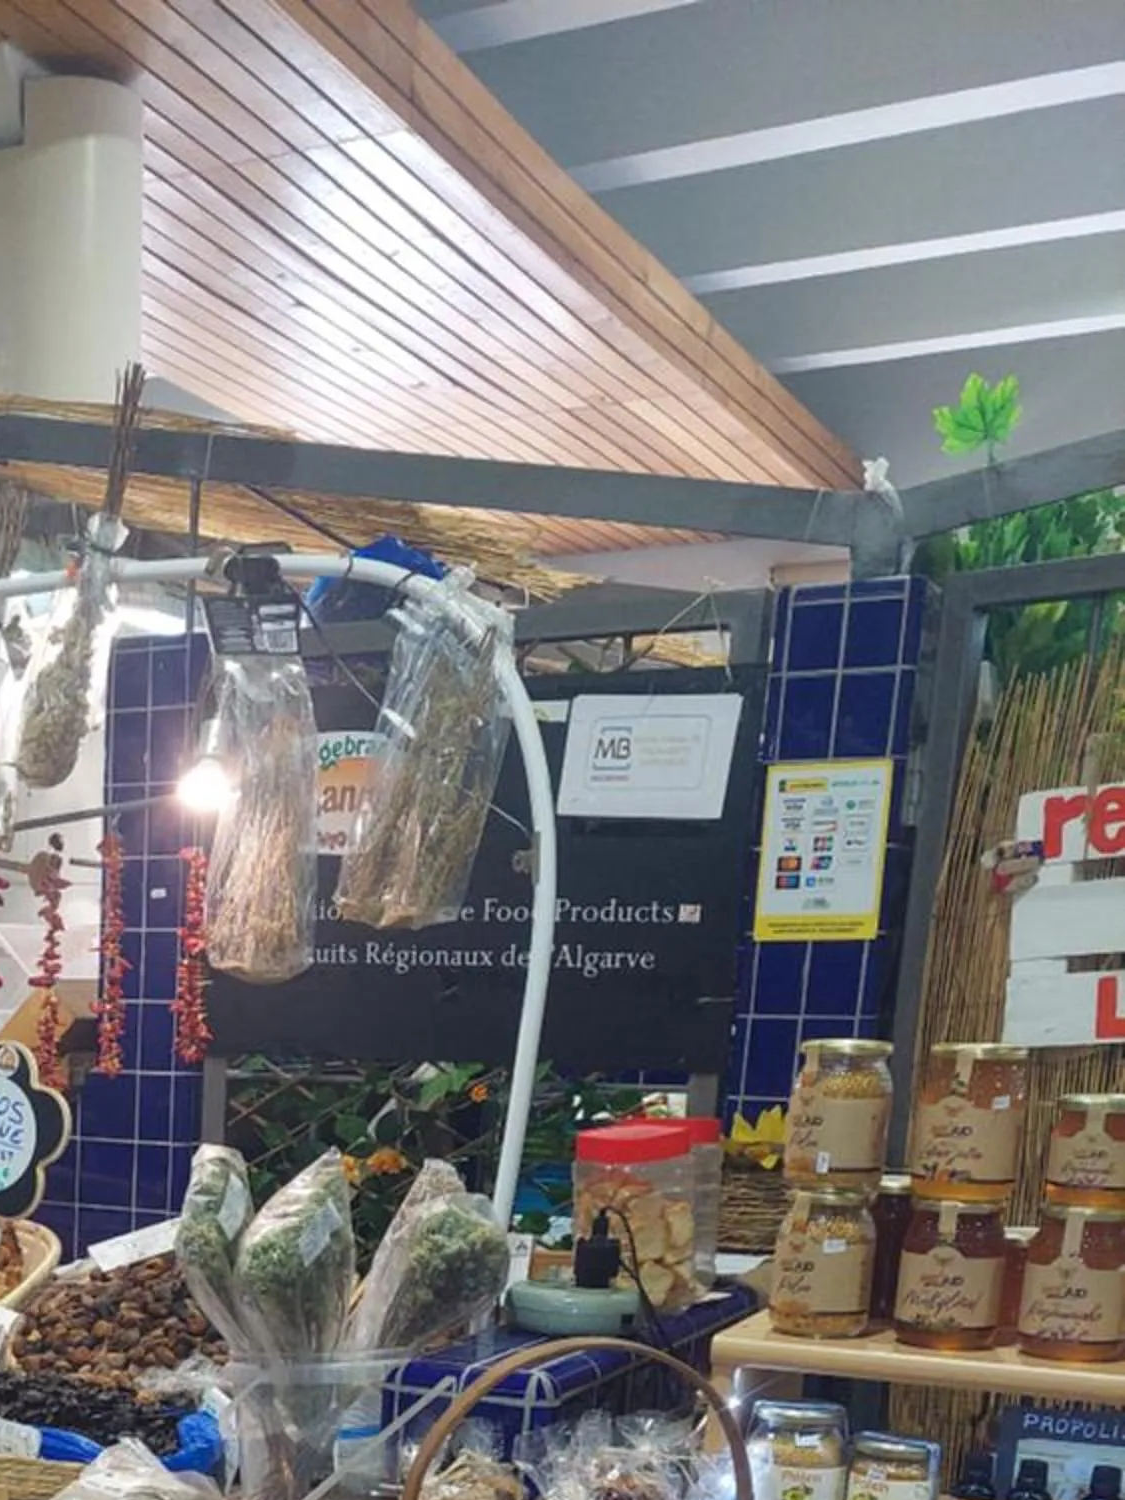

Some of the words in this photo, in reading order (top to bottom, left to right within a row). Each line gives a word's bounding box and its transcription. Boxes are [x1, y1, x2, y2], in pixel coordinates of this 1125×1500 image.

[594, 737, 631, 760] MB
[484, 899, 536, 922] Foo
[555, 899, 674, 923] Products
[365, 942, 493, 974] Régionaux
[548, 942, 656, 977] 'Algarve
[1022, 1412, 1125, 1439] PROPOLI
